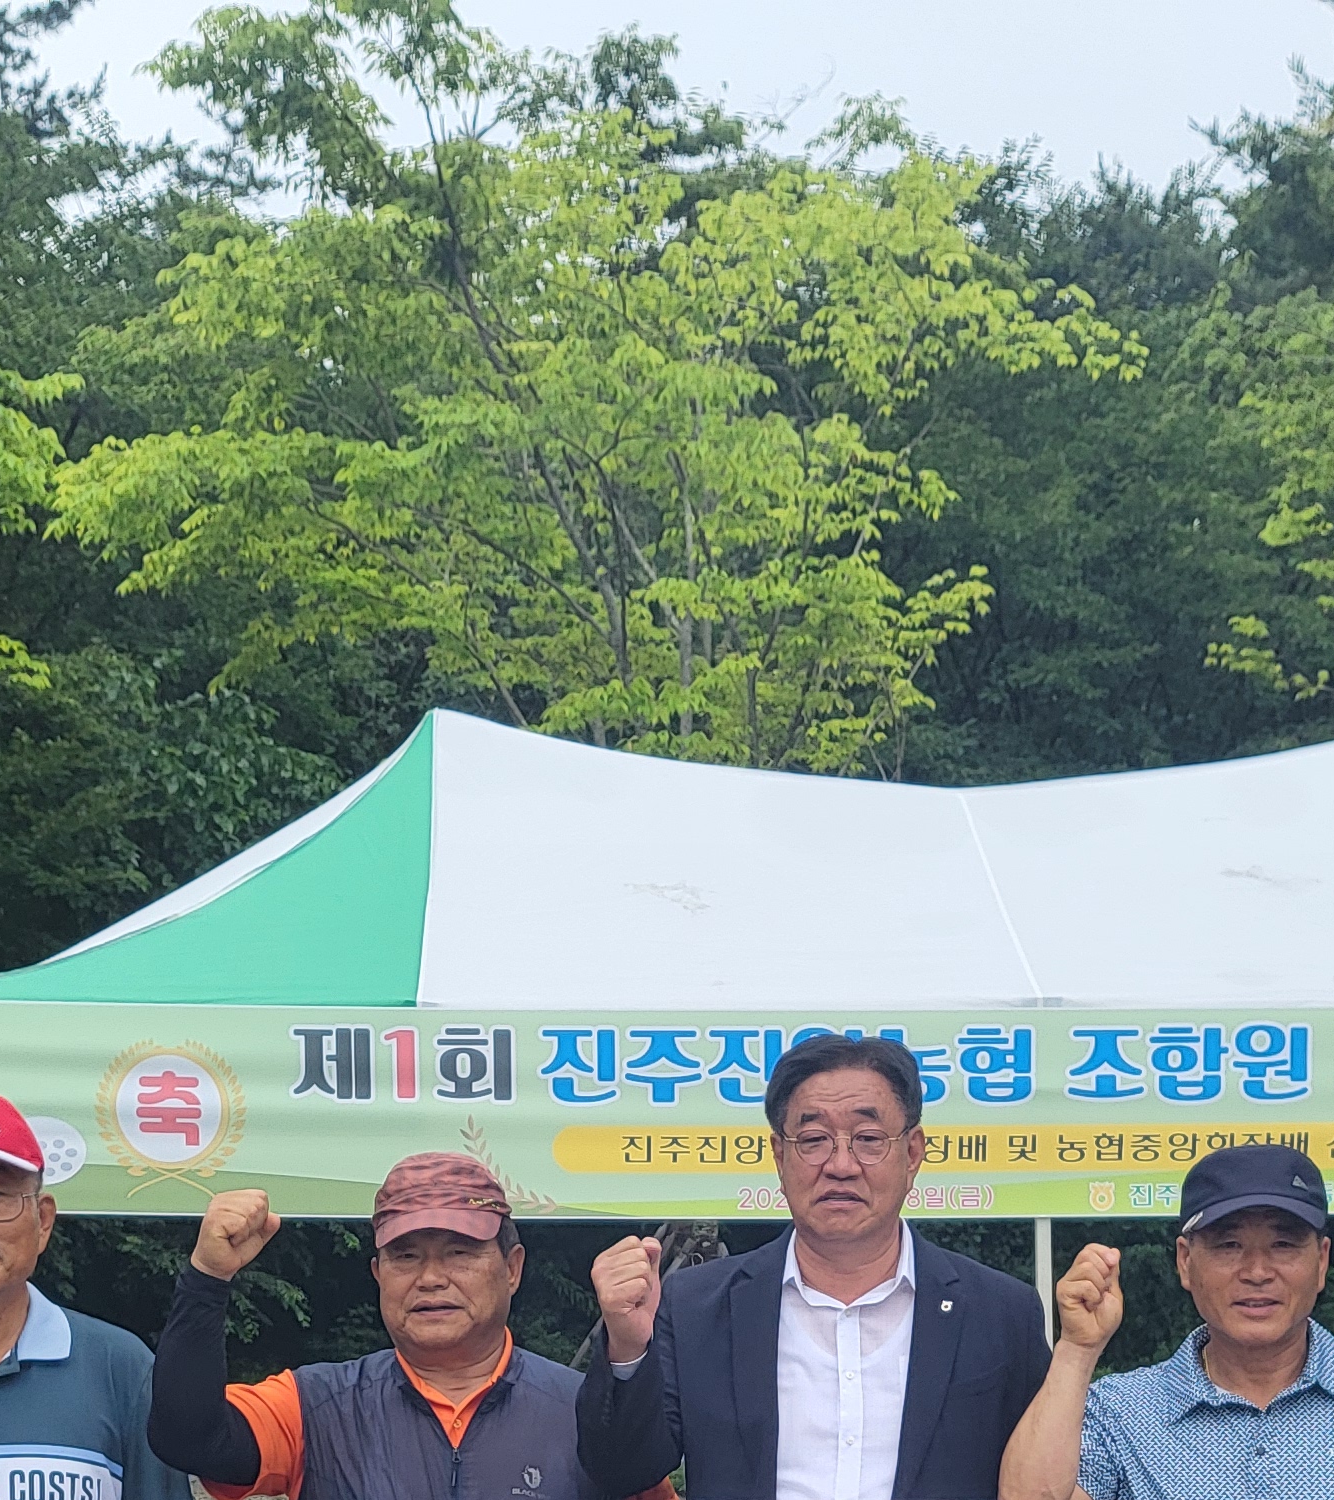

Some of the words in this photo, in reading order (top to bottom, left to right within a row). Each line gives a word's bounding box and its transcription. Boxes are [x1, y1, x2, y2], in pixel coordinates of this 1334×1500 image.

[293, 1025, 513, 1102] 제1회
[539, 1025, 1034, 1104] 진주진협
[1067, 1023, 1310, 1103] 조합원
[135, 1070, 202, 1146] 축
[1007, 1132, 1038, 1164] 및
